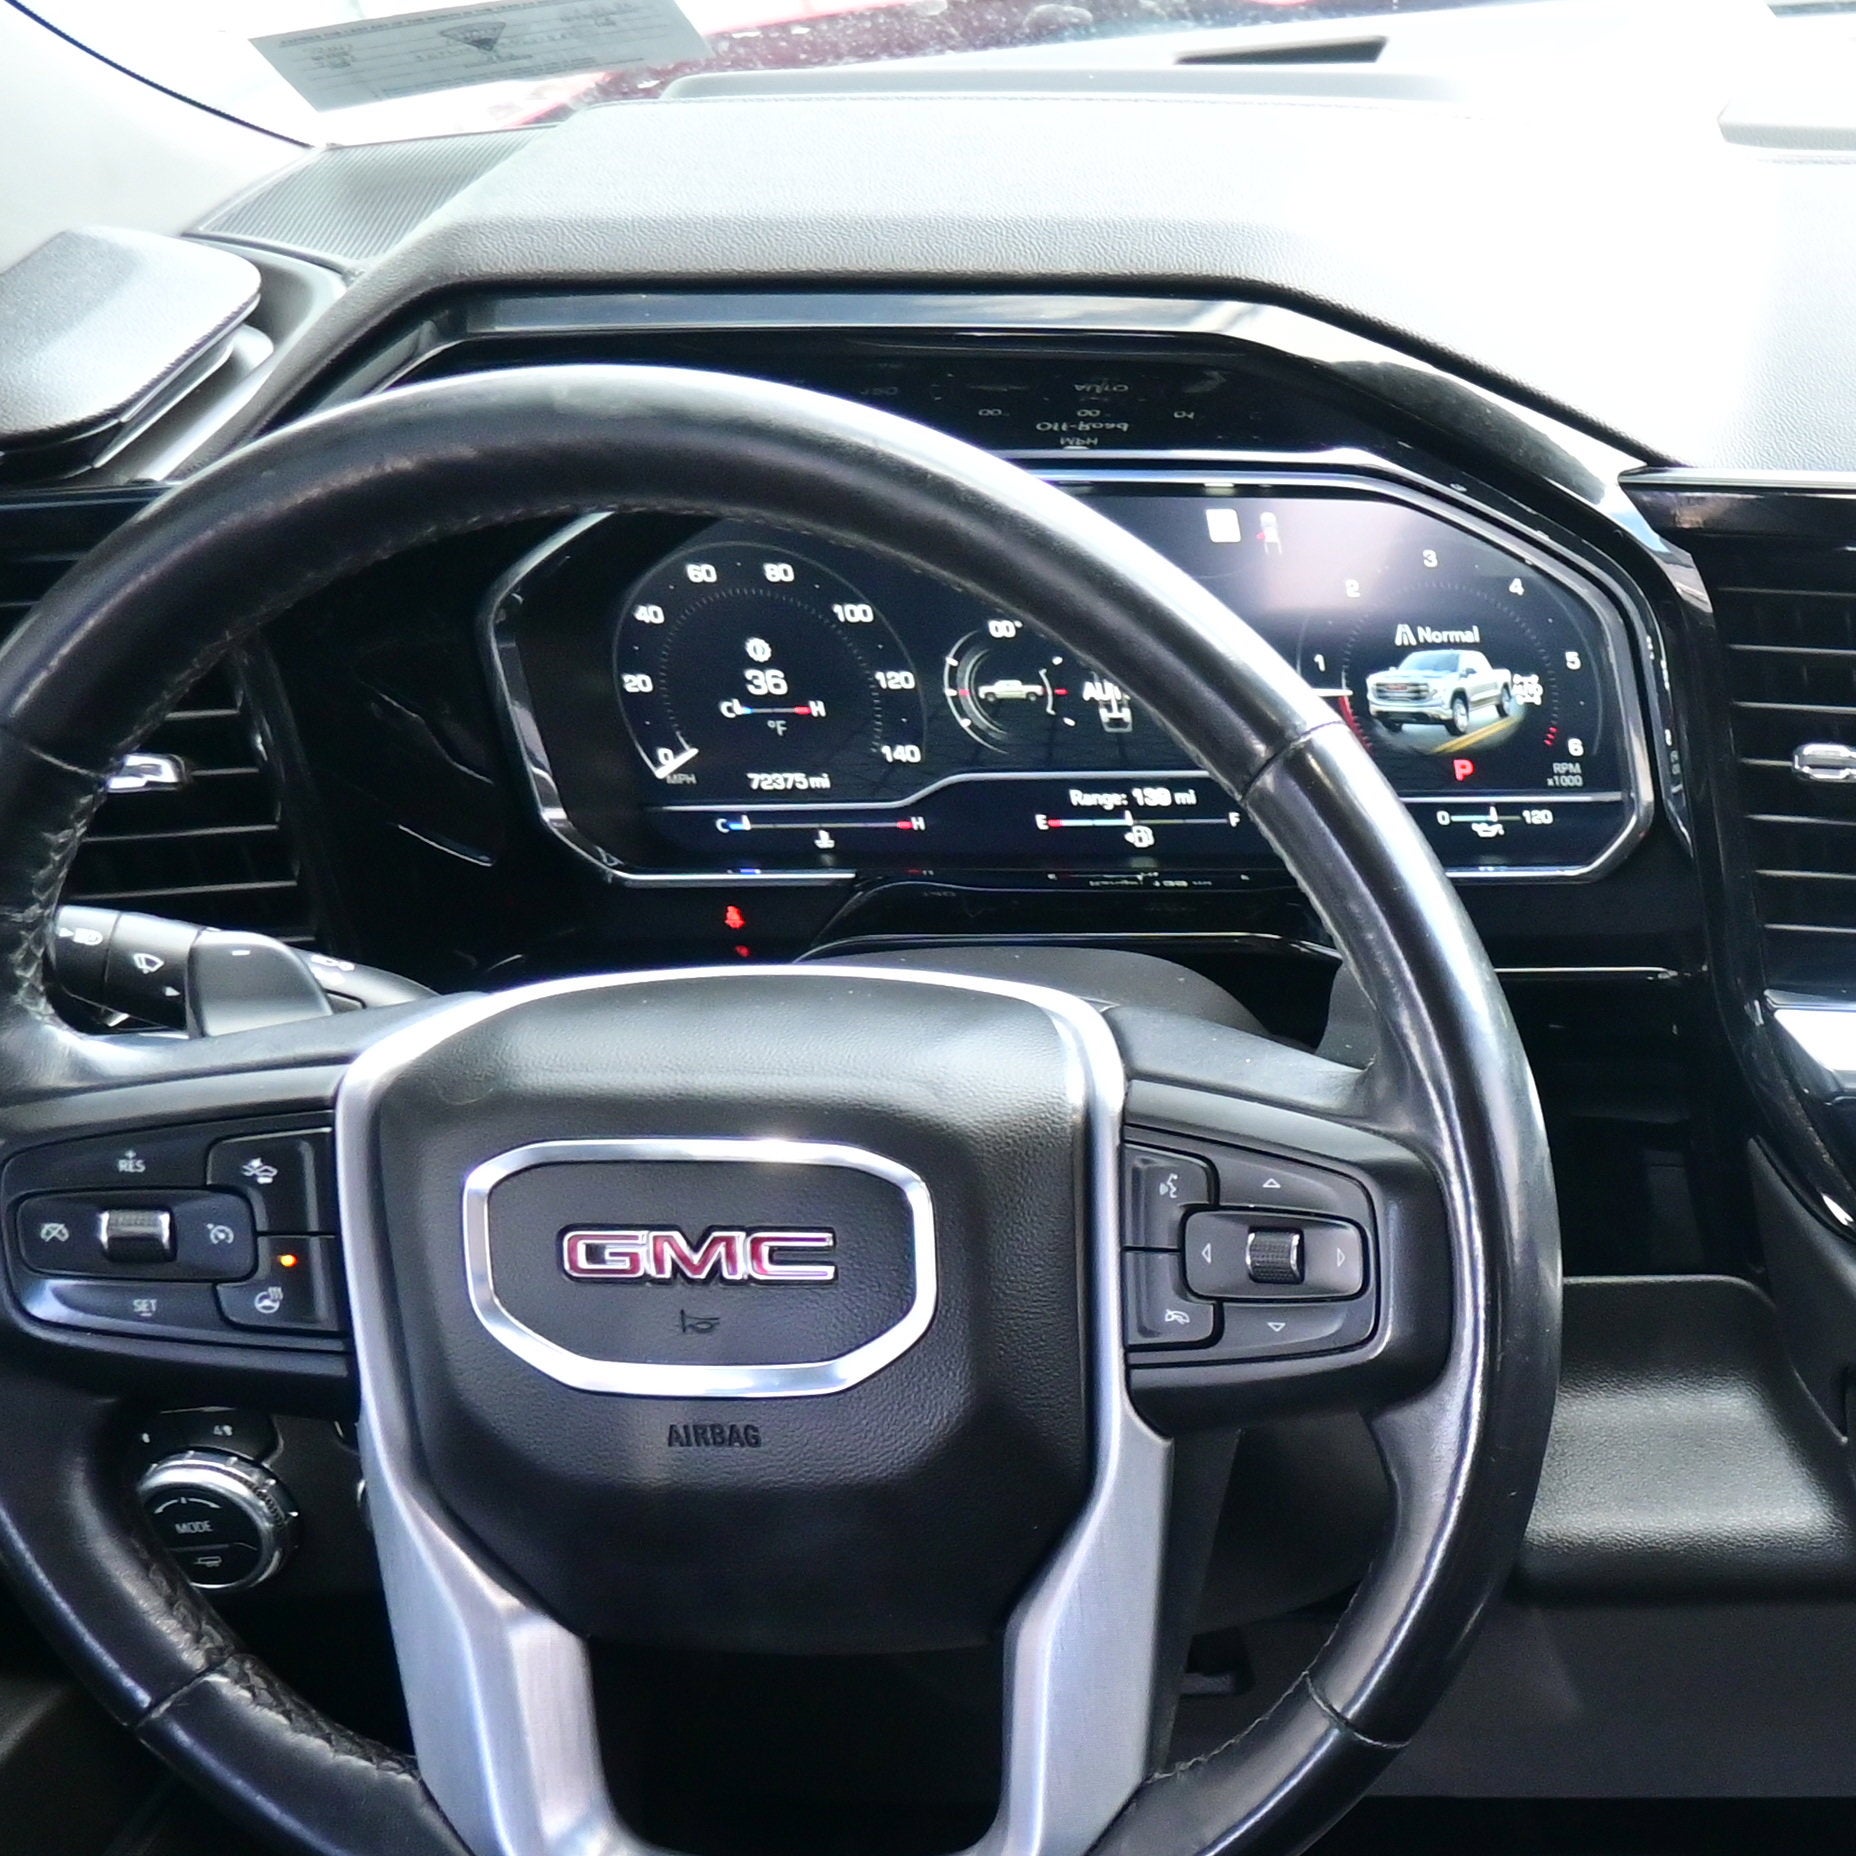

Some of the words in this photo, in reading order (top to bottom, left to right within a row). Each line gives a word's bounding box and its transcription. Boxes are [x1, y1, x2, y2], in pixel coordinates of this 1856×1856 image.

[1423, 549, 1438, 568] 3
[687, 563, 716, 583] 60
[764, 563, 794, 583] 80
[1345, 579, 1360, 598] 2
[1509, 577, 1524, 596] 4
[634, 604, 665, 624] 40
[832, 604, 874, 623] 100
[1417, 625, 1480, 644] Normal
[1313, 653, 1326, 671] 1
[1565, 651, 1581, 670] 5
[623, 674, 654, 693] 20
[745, 668, 788, 695] 36
[876, 671, 915, 690] 120
[720, 701, 735, 718] C
[811, 702, 827, 718] H
[768, 719, 787, 736] °F
[881, 744, 921, 763] 140
[1568, 738, 1583, 756] 6
[1453, 758, 1474, 781] P
[1553, 761, 1581, 775] RPM
[747, 771, 807, 791] 72375
[1547, 775, 1583, 787] x1000
[1069, 788, 1129, 810] Range:
[1174, 788, 1197, 805] mi
[715, 817, 729, 833] C
[911, 817, 926, 831] H
[1035, 814, 1049, 830] E
[1228, 812, 1241, 828] F
[1436, 810, 1451, 826] 0
[1522, 809, 1553, 825] 120
[117, 1158, 146, 1173] RES
[561, 1228, 837, 1283] GMC
[133, 1298, 157, 1313] SET
[667, 1422, 762, 1449] AIRBAG
[174, 1520, 214, 1534] MODE
